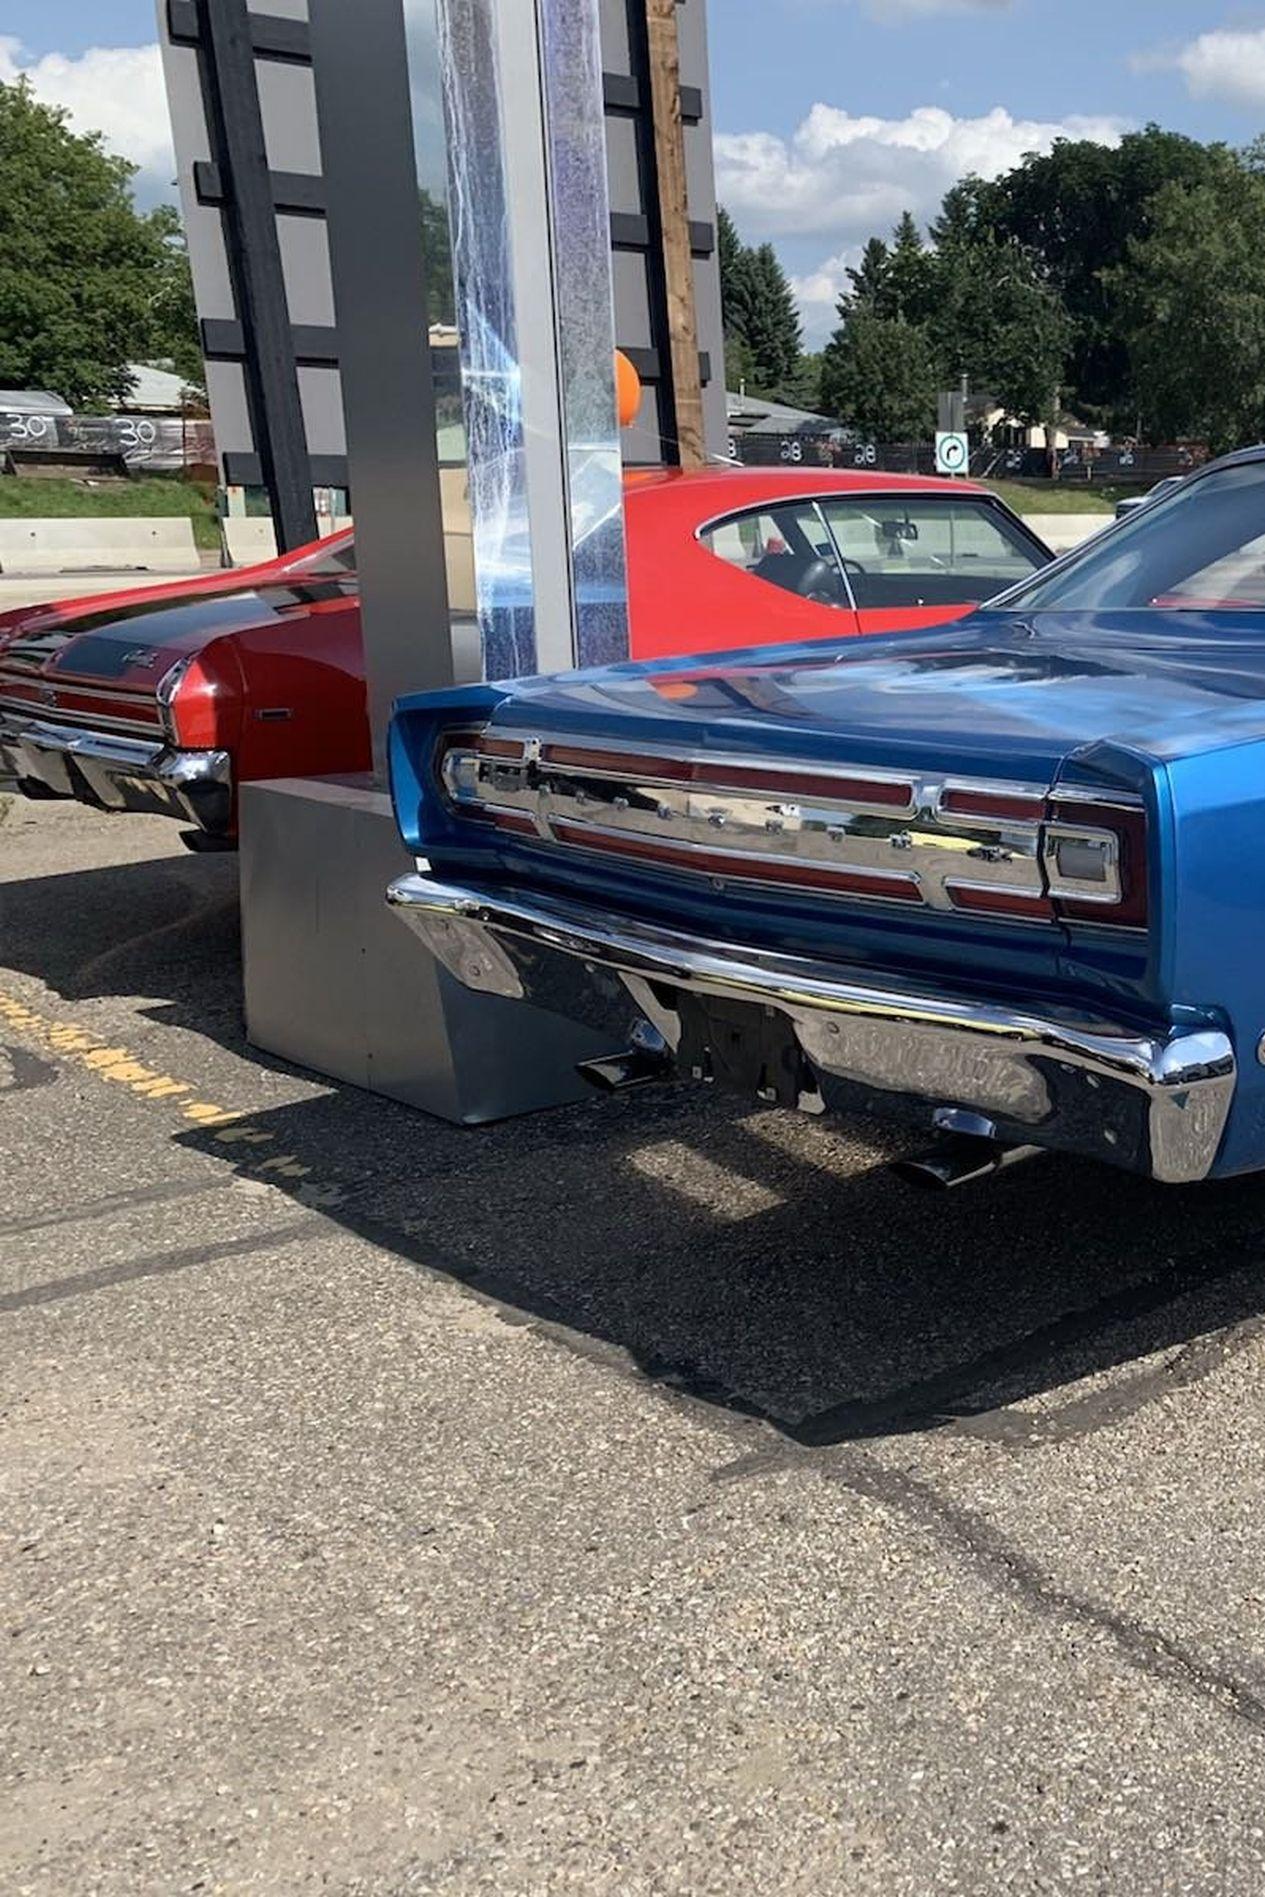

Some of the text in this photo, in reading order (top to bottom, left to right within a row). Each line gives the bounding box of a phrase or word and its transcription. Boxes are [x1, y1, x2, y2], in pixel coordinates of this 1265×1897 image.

[6, 413, 47, 438] 30
[114, 418, 156, 446] 30
[780, 440, 802, 462] 28
[854, 444, 876, 464] 28
